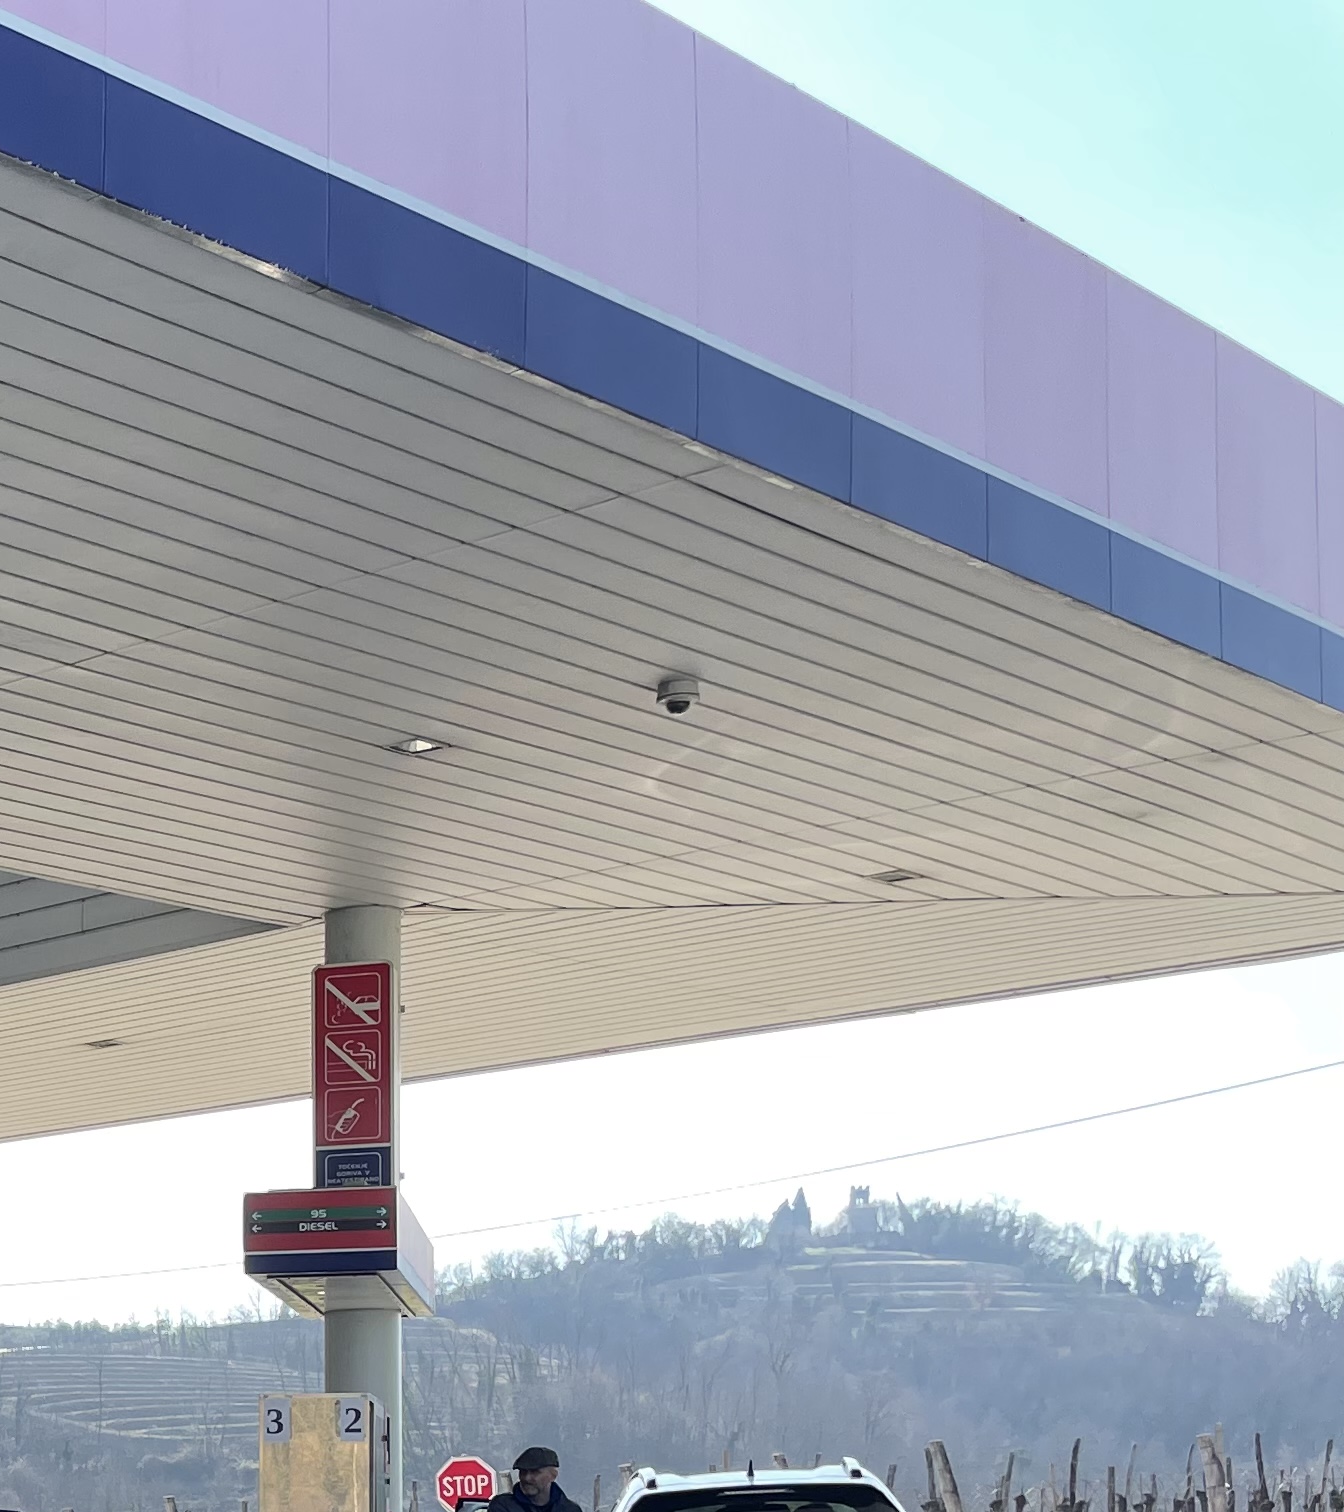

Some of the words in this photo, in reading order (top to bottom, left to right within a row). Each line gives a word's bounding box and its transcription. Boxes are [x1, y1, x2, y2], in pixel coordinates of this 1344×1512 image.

[310, 1209, 327, 1219] 95
[298, 1221, 339, 1232] DIESEL
[266, 1408, 284, 1435] 3
[344, 1407, 362, 1433] 2
[442, 1474, 489, 1498] STOP
